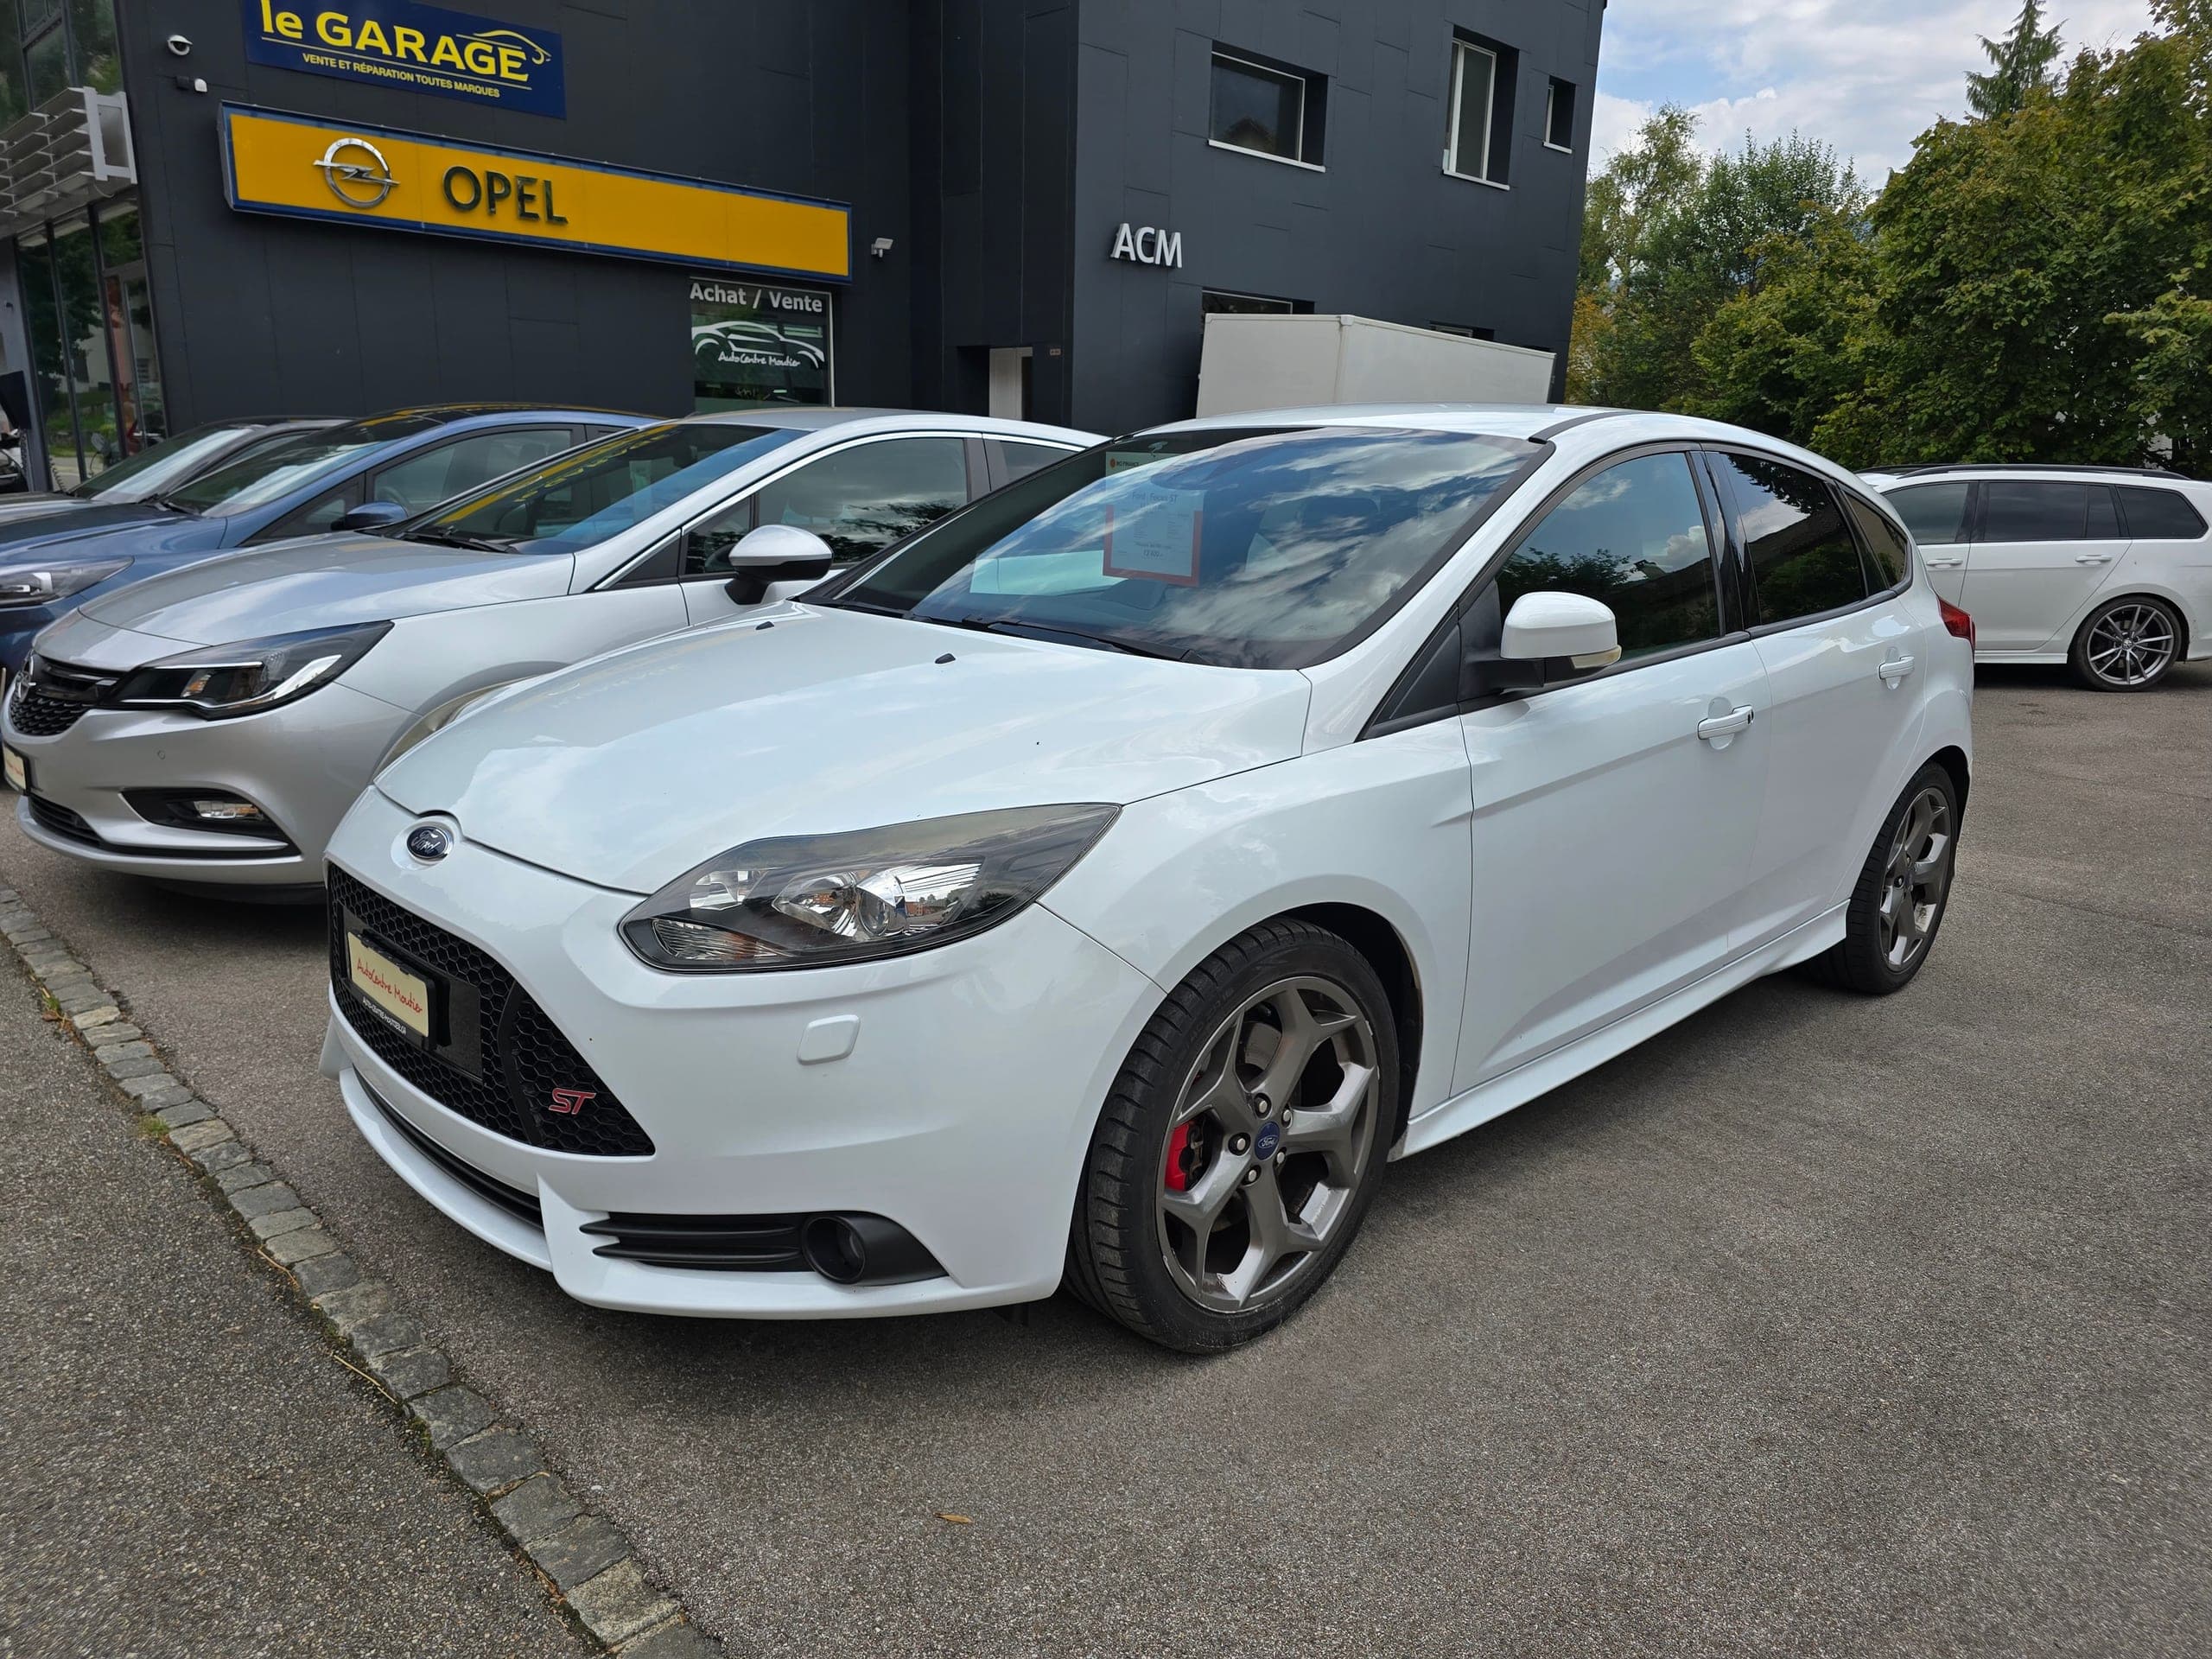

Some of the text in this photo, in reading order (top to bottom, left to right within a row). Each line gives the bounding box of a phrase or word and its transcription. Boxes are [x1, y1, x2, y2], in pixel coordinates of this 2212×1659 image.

[261, 0, 529, 82] le GARAGE
[302, 53, 500, 98] VENTE ET RÉPARATION TOUTES MARQUES
[442, 165, 569, 225] OPEL
[1110, 223, 1183, 268] ACM
[690, 283, 747, 305] Achat
[769, 291, 823, 313] Vente
[768, 355, 801, 367] Moutier
[410, 830, 442, 855] Ford
[548, 1087, 597, 1116] ST
